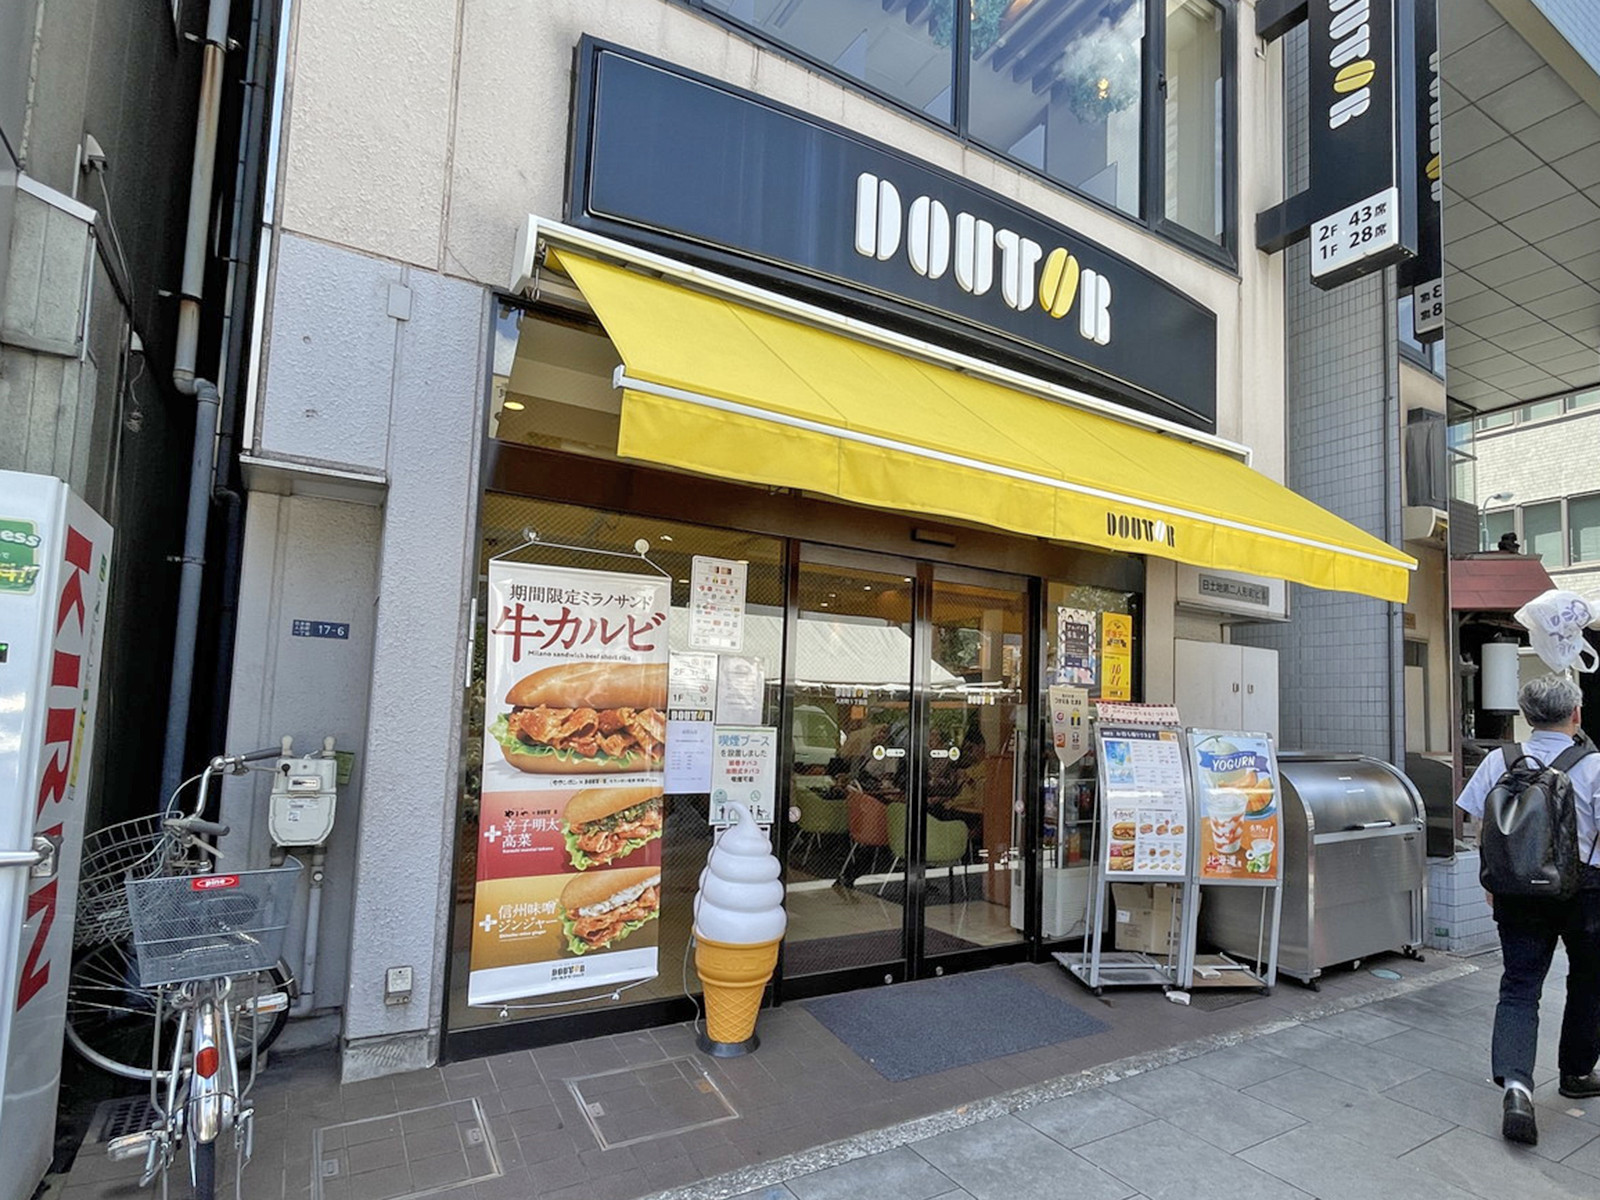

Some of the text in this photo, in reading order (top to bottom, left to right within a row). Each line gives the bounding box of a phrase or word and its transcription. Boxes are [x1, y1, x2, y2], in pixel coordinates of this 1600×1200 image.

[1329, 0, 1375, 130] UTOR
[1319, 202, 1387, 242] 2F 43席
[1319, 222, 1387, 260] 1F 28席
[855, 172, 1112, 346] DOUTOR
[1107, 511, 1176, 548] DOUTOR
[0, 530, 41, 549] ess
[509, 584, 653, 610] 期間限定ミラノサンド
[318, 624, 345, 637] 17-6
[491, 602, 667, 663] 牛カルビ
[670, 710, 711, 721] DOUTOR
[718, 734, 770, 747] 喫煙ブース
[720, 749, 768, 758] を設置しました
[1212, 755, 1256, 772] YOGURN
[502, 818, 560, 833] 辛子明太
[502, 833, 533, 848] 高菜
[499, 917, 558, 933] ジンジャー
